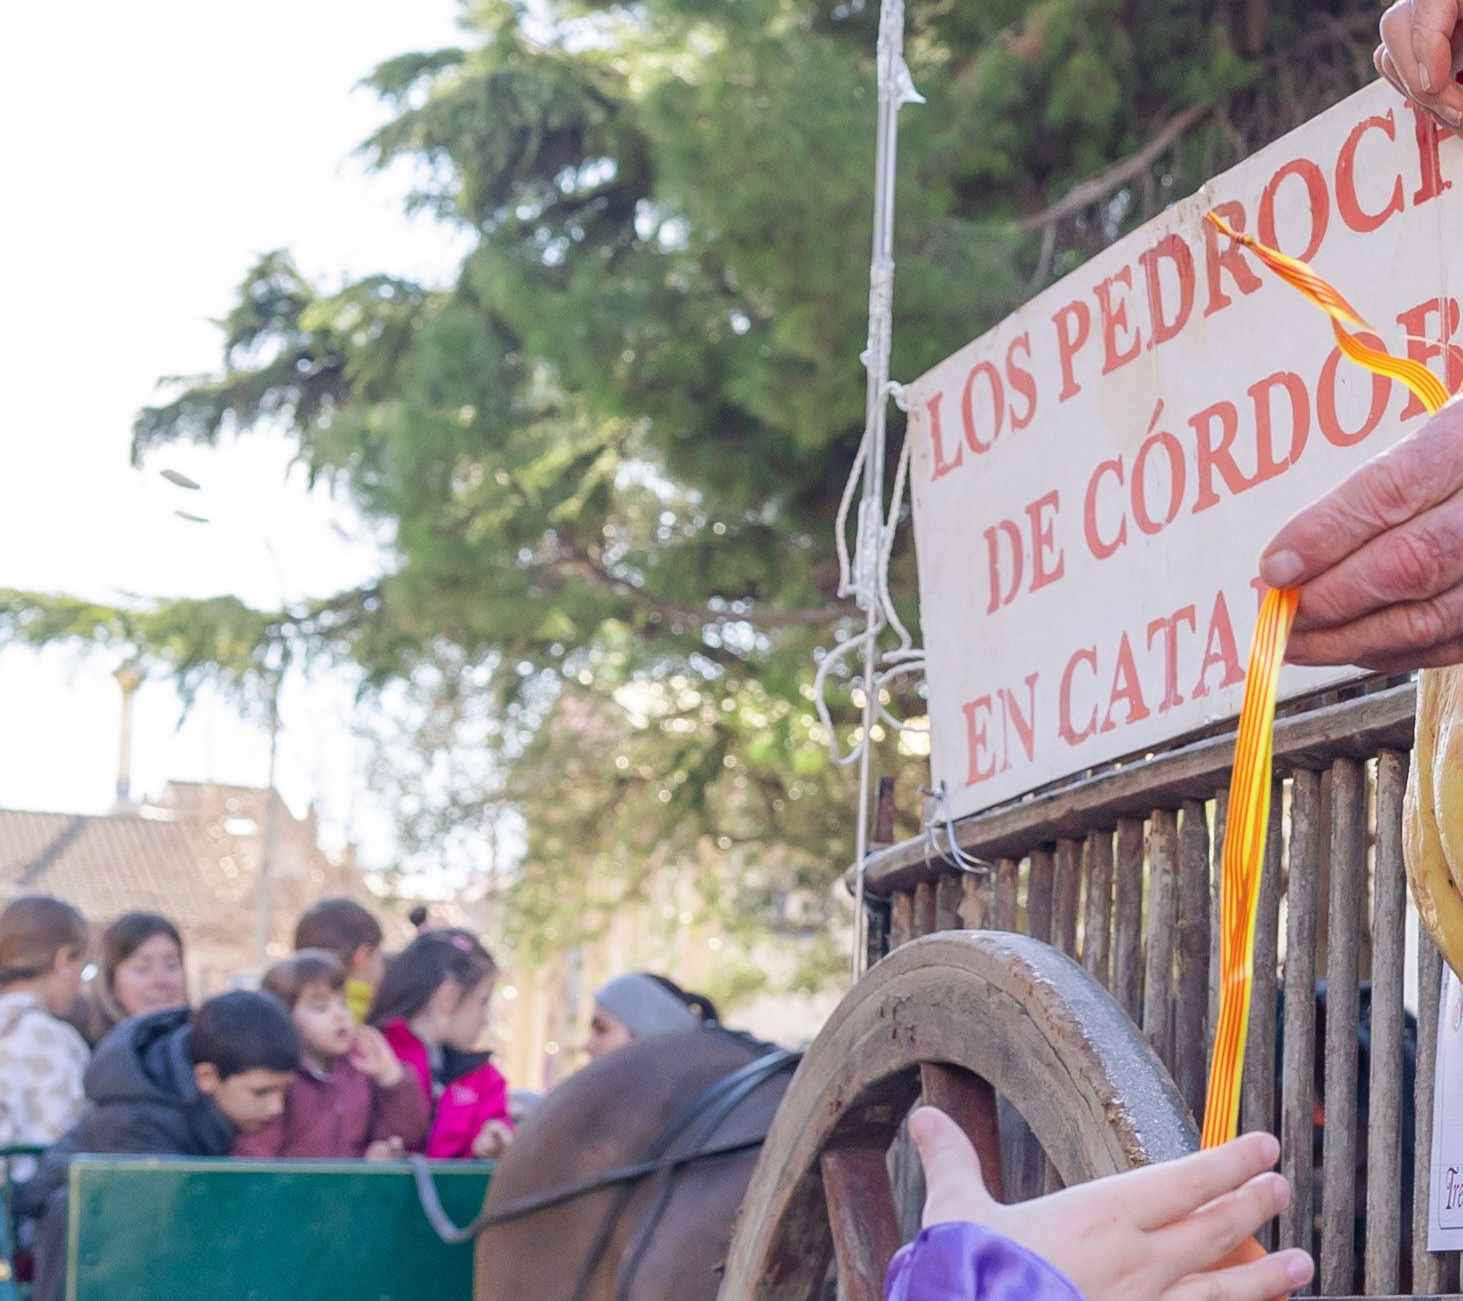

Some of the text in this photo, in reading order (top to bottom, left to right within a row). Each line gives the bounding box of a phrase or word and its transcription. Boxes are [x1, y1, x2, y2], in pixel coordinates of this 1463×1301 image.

[926, 331, 1037, 483] LOS
[983, 489, 1065, 616] DE
[961, 576, 1274, 788] EN CATA
